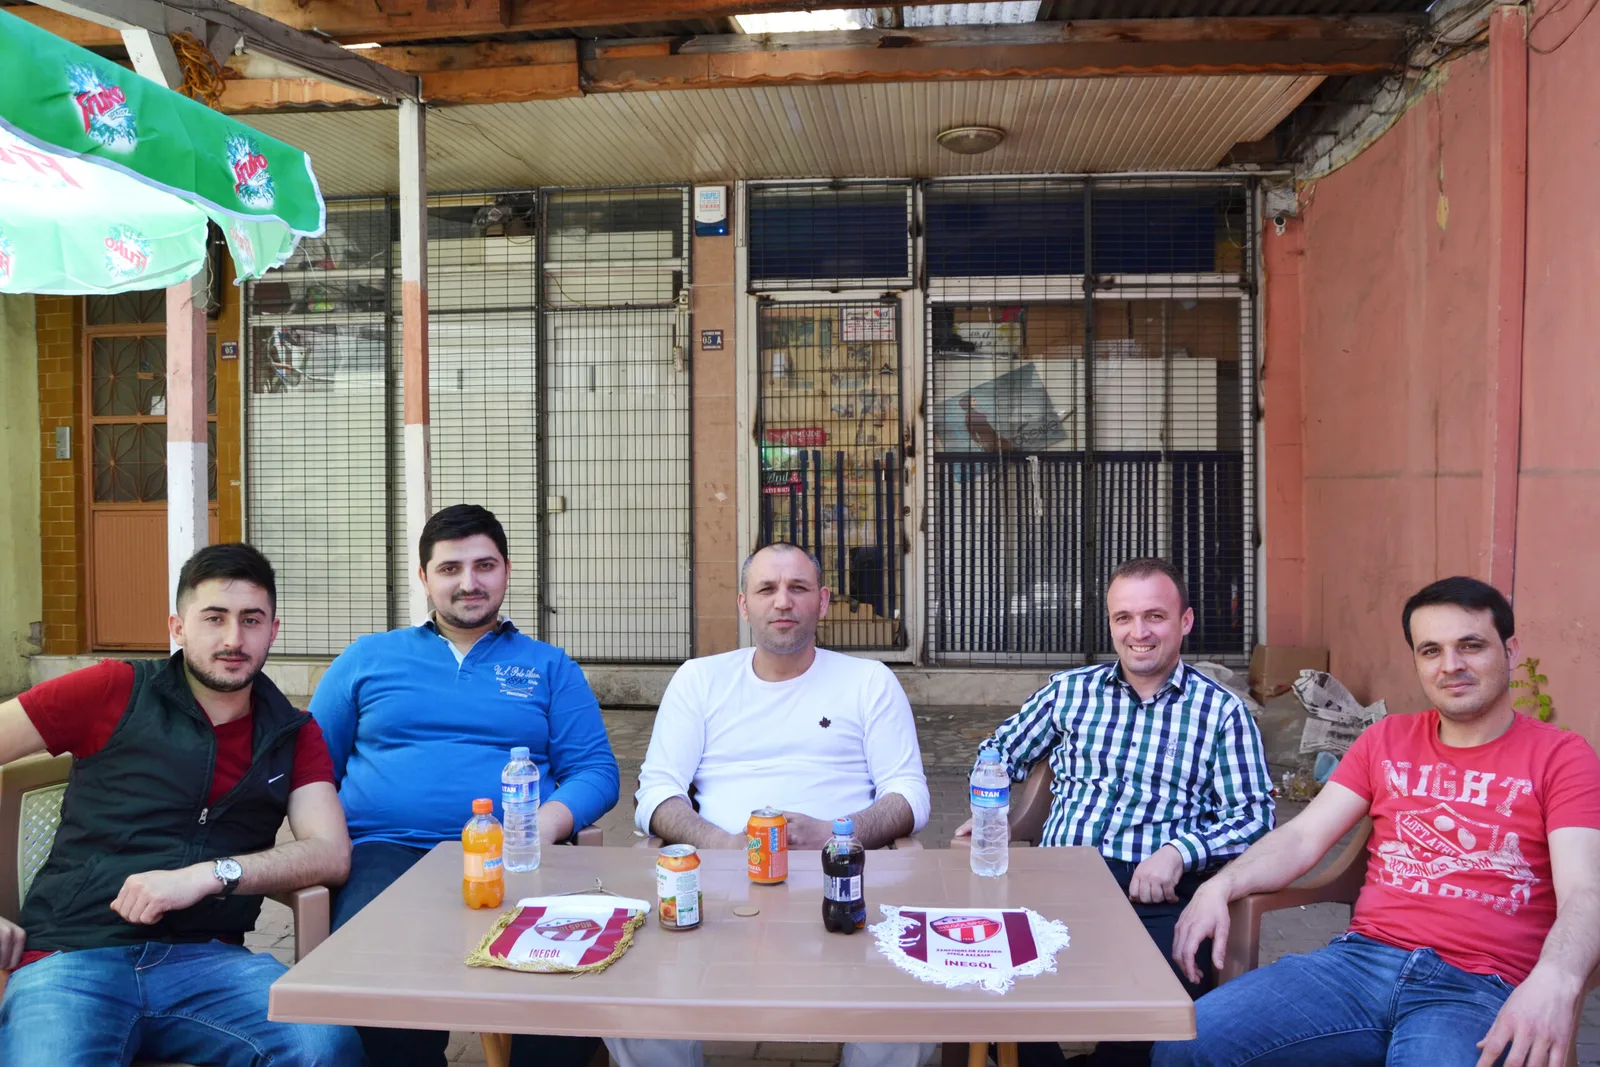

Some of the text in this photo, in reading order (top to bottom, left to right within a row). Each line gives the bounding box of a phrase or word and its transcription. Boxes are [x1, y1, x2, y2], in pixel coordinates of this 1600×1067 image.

[1381, 759, 1534, 818] NIGHT
[1402, 815, 1431, 839] LOFT
[1452, 855, 1494, 870] TEAM
[944, 958, 998, 970] İNEGÖL
